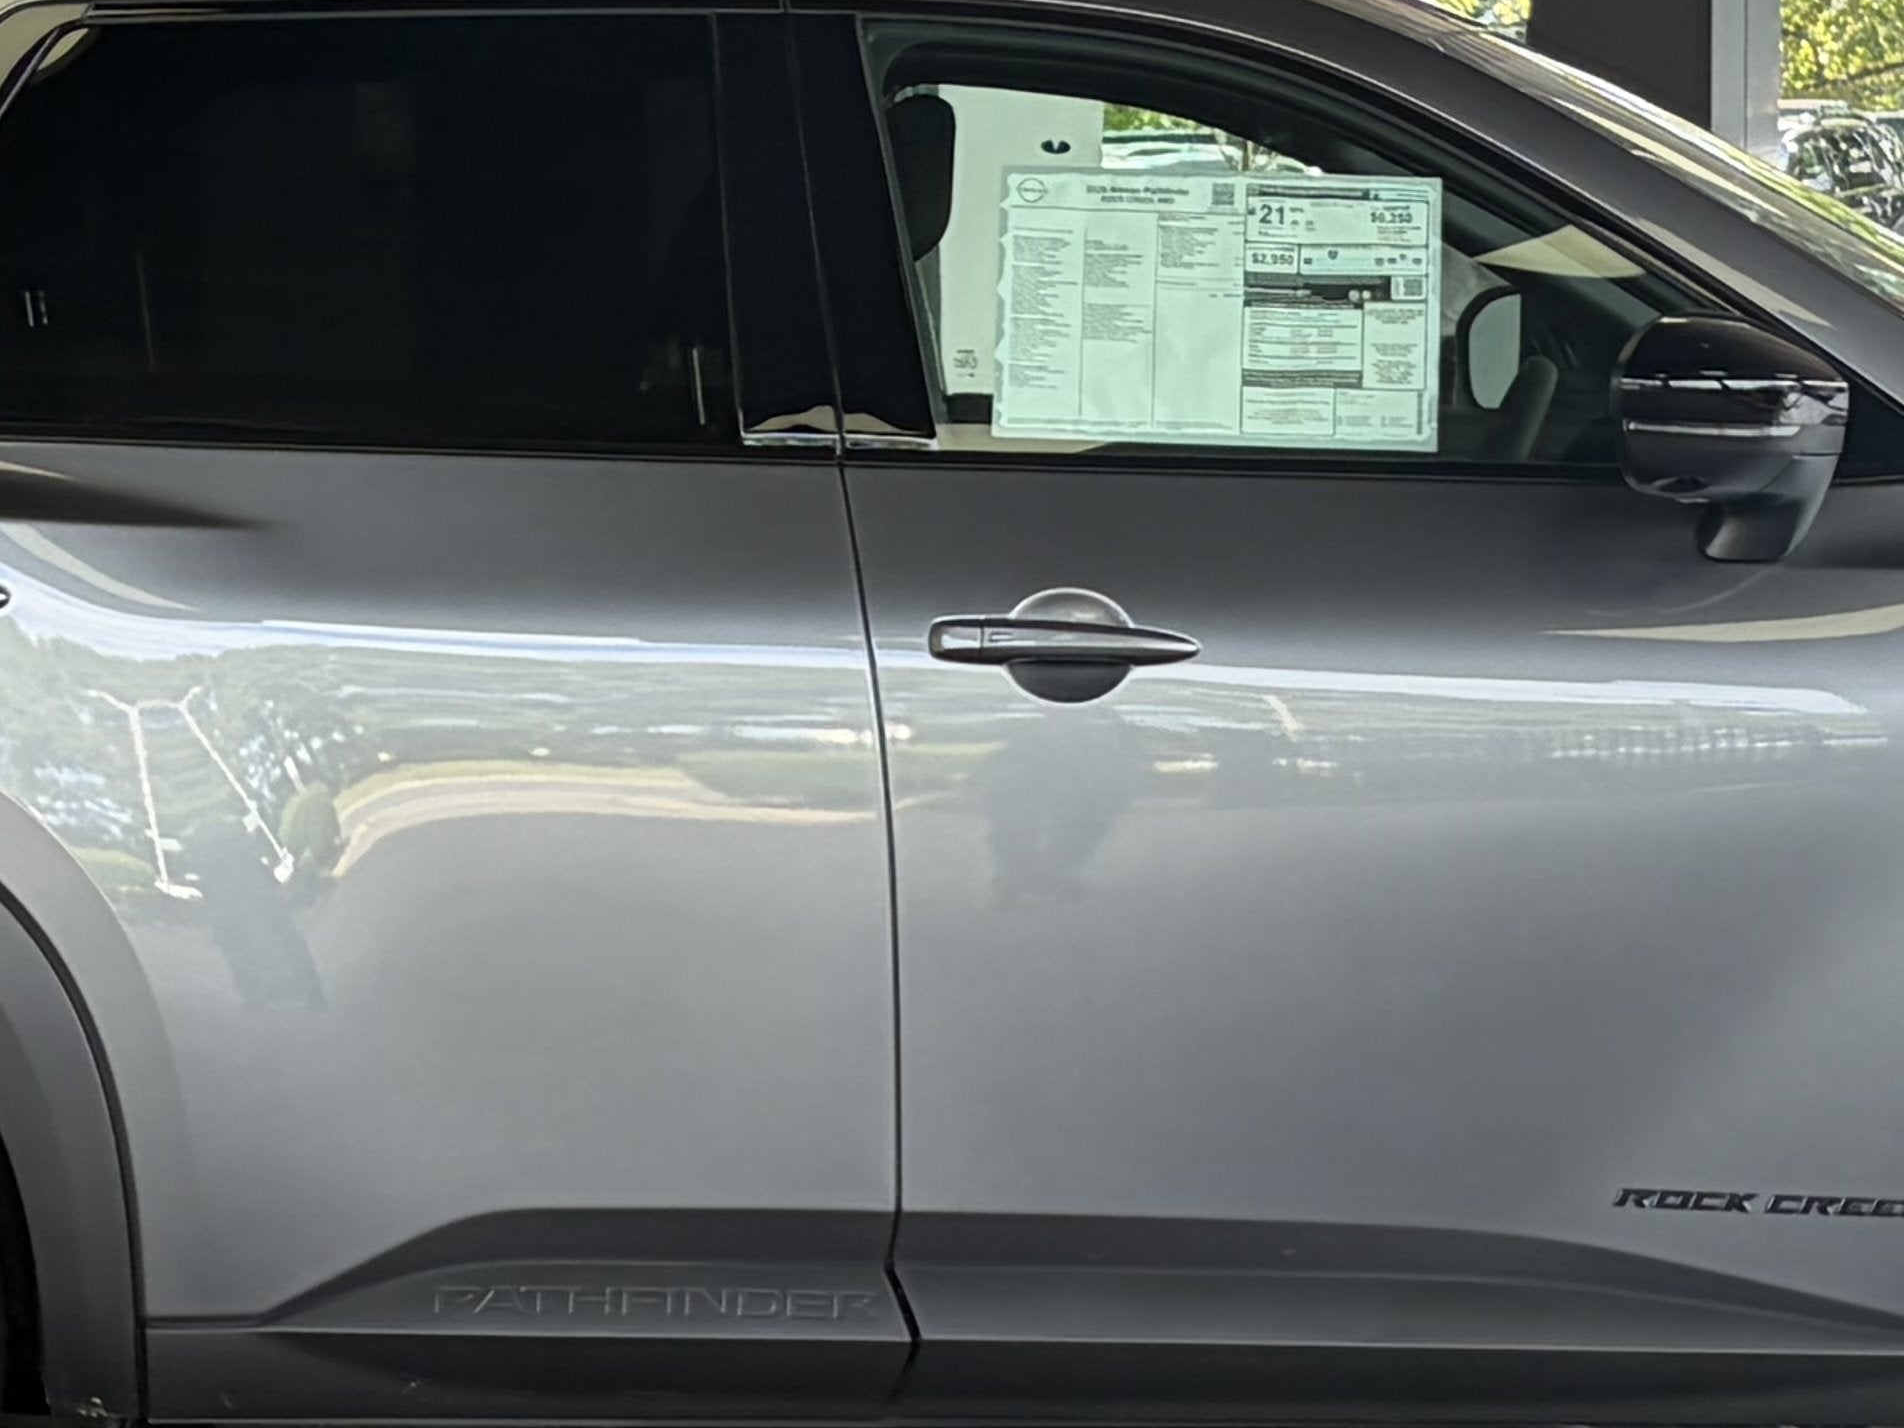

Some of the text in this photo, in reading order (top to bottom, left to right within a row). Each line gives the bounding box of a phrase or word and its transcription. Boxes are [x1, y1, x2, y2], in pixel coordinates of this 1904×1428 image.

[1259, 203, 1285, 225] 21
[1612, 1187, 1760, 1214] ROCK
[433, 1284, 880, 1320] PATHFINDER
